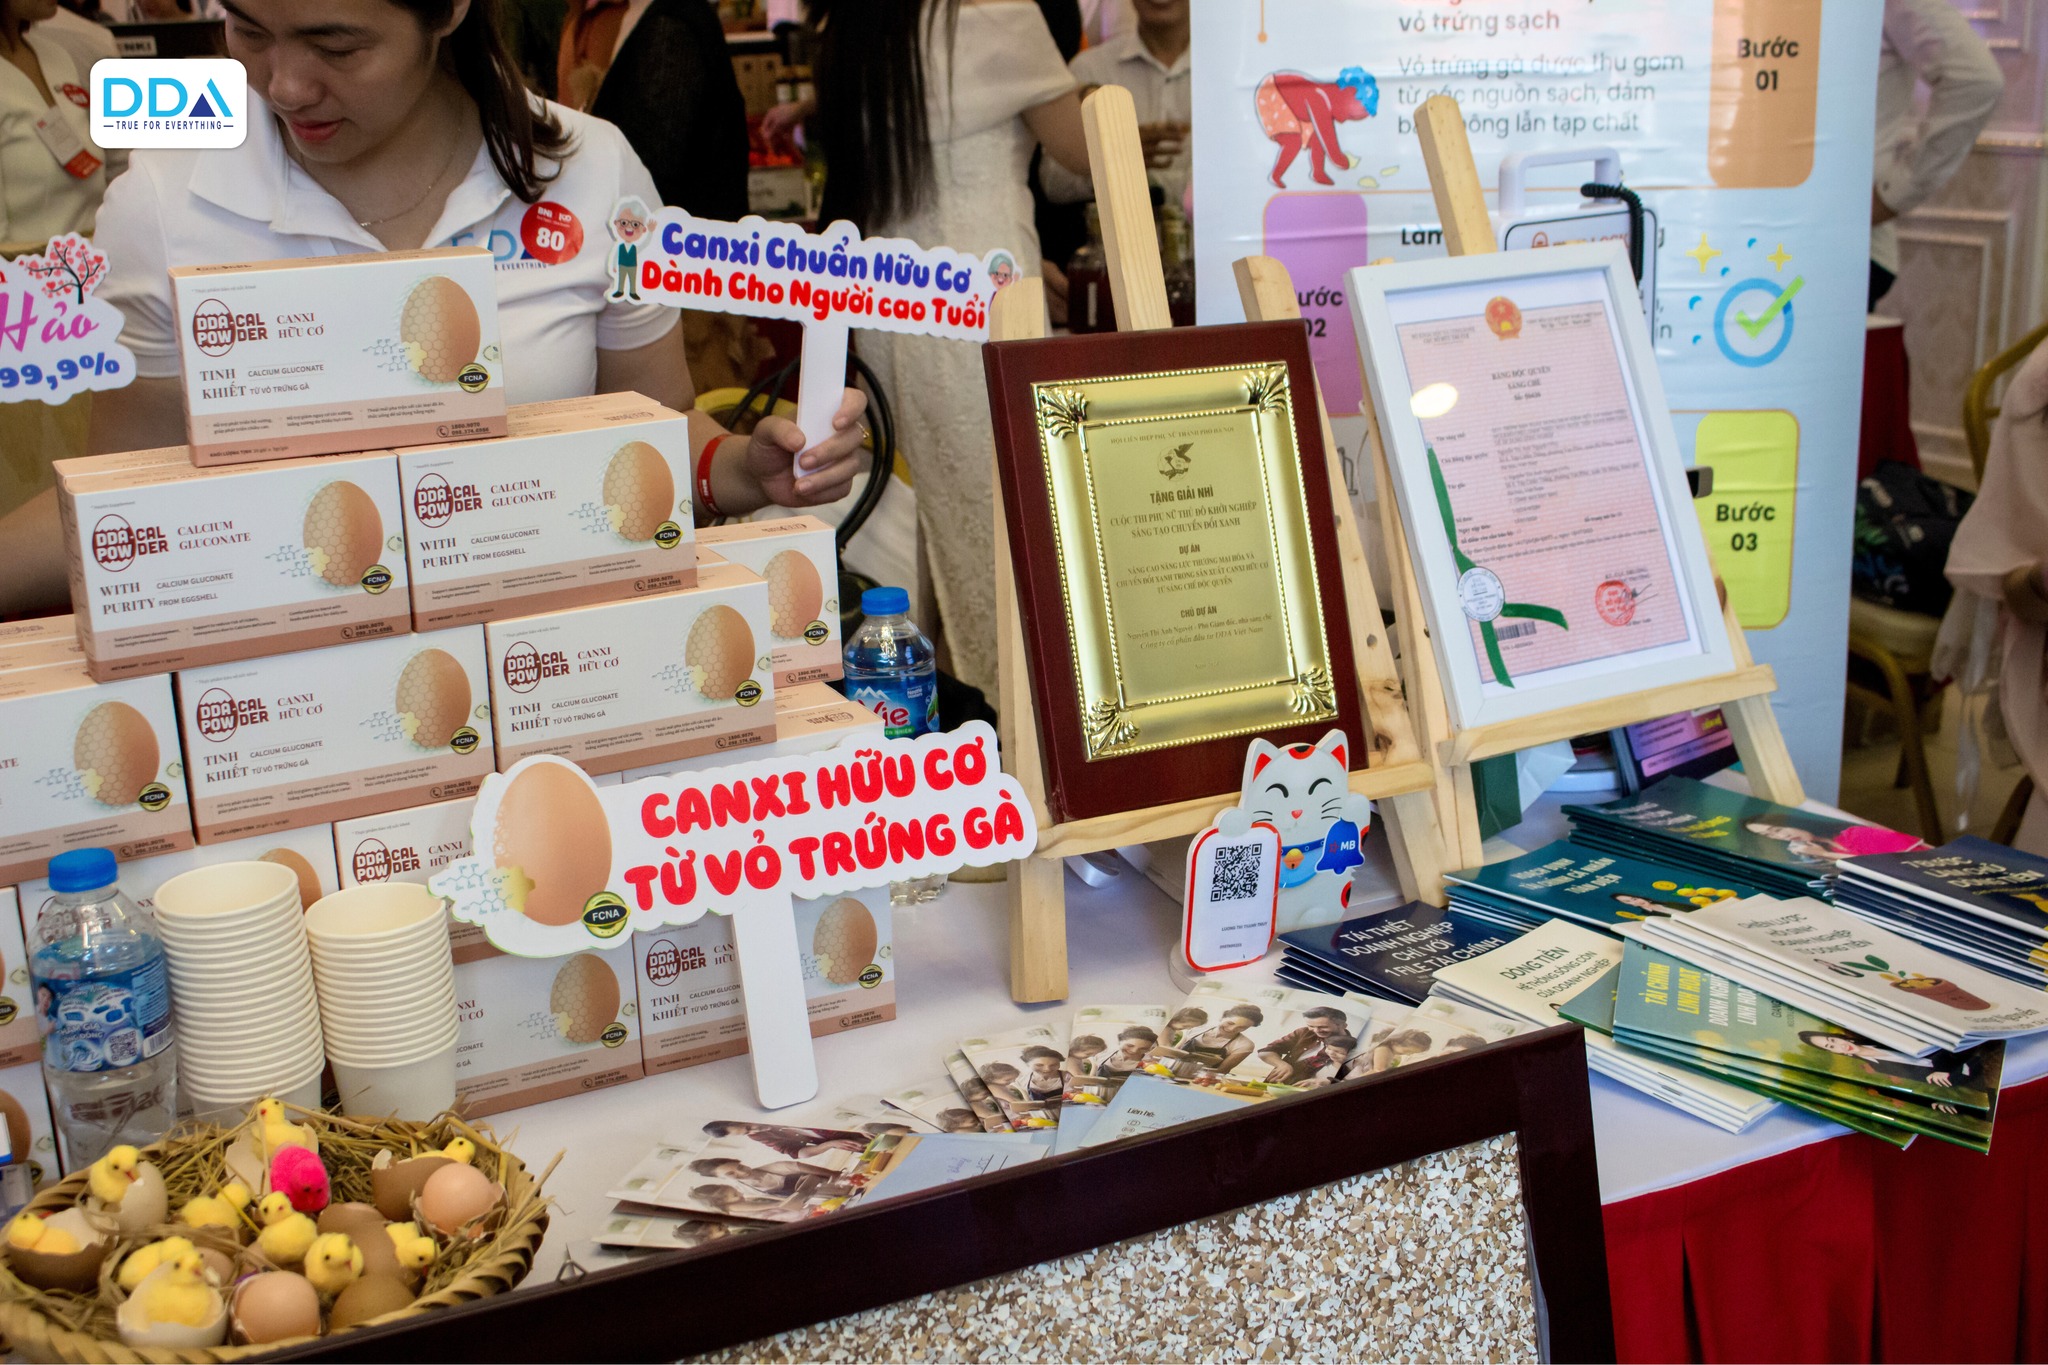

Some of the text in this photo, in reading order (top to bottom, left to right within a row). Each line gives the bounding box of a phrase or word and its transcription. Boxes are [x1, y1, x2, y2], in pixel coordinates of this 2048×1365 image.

[1399, 10, 1560, 36] vỏ trứng sạch
[1737, 35, 1799, 58] Bước
[1593, 54, 1626, 72] thu
[1633, 55, 1684, 75] gom
[1756, 69, 1778, 91] 01
[1399, 84, 1420, 102] từ
[1473, 81, 1539, 107] nguồn
[1553, 114, 1586, 139] tạp
[1592, 111, 1639, 131] chất
[536, 227, 565, 251] 80
[502, 262, 547, 271] EVERYTHING
[661, 223, 971, 293] Canxi Chuẩn Hữu Cơ
[641, 260, 985, 329] Dành Cho Người cao Tuổi
[1298, 286, 1343, 307] ước
[0, 290, 99, 352] Hảo
[196, 313, 315, 330] DDA-CAL CANXI
[278, 327, 303, 338] HỮU
[307, 325, 324, 336] CƠ
[0, 352, 120, 390] 99,9%
[200, 364, 324, 381] TINH CALCIUM GLUCONATE
[463, 374, 483, 382] FCNA
[202, 381, 309, 399] KHIẾT TỪ VỎ TRỨNG GÀ
[418, 479, 541, 503] DDA-CAL CALCIUM
[491, 490, 557, 508] GLUCONATE
[1150, 484, 1214, 505] TẶNG GIẢI NHÌ
[1134, 514, 1147, 523] THI
[1149, 513, 1164, 522] PHỤ
[1229, 500, 1257, 512] NGHIỆP
[1715, 503, 1776, 523] Bước
[95, 520, 233, 547] DDA-CAL CALCIUM
[659, 531, 677, 539] FCNA
[1155, 526, 1170, 536] TẠO
[1220, 517, 1240, 527] XANH
[179, 532, 251, 550] GLUCONATE
[420, 529, 540, 552] WITH CALCIUM GLUCONATE
[1731, 533, 1758, 552] 03
[422, 547, 526, 569] PURITY FROM EGGSHELL
[100, 572, 234, 597] WITH CALCIUM GLUCONATE
[367, 576, 387, 584] FCNA
[103, 592, 218, 615] PURITY FROM EGGSHELL
[1180, 606, 1195, 618] CHỦ
[808, 629, 825, 637] FCNA
[508, 647, 612, 670] DDA-CAL CANXI
[579, 656, 619, 674] HỮU CƠ
[509, 692, 619, 717] TINH CALCIUM GLUCONATE
[740, 689, 757, 698] FCNA
[201, 693, 314, 719] DDA-CAL CANXI
[279, 703, 323, 720] HỮU CƠ
[511, 712, 551, 732] KHIẾT
[553, 717, 564, 726] TỪ
[573, 712, 596, 722] TRỨNG
[596, 709, 606, 718] GÀ
[456, 736, 474, 745] FCNA
[204, 740, 323, 766] TINH CALCIUM GLUCONATE
[206, 764, 249, 783] KHIẾT
[252, 766, 263, 775] TỪ
[274, 761, 298, 771] TRỨNG
[299, 758, 309, 767] GÀ
[640, 734, 989, 839] CANXI HỮU CƠ
[356, 840, 463, 868] DDA-CAL CANXI
[623, 788, 1024, 912] TỪ VỎ TRỨNG GÀ
[1340, 840, 1356, 851] MB
[592, 907, 621, 923] FCNA
[1339, 919, 1415, 943] TÁI THIẾT
[1341, 921, 1454, 957] DOANH NGHIỆP
[649, 946, 705, 966] DDA-CAL
[1391, 939, 1455, 961] CHỈ VỚI
[1393, 962, 1433, 976] FILE
[1428, 955, 1458, 968] TÀI
[1453, 936, 1506, 960] CHÍNH
[1499, 946, 1570, 980] DÒNG TIỀN
[1526, 972, 1558, 987] THỐNG
[1554, 961, 1580, 976] SỐNG
[863, 972, 879, 980] FCNA
[1537, 958, 1611, 998] CỦA DOANH NGHIỆP
[1638, 962, 1670, 1006] TÀI CHÍNH
[651, 989, 715, 1007] TINH CALCIUM
[1677, 967, 1707, 1015] LINH HOẠT
[469, 1009, 484, 1020] CƠ
[652, 1004, 688, 1021] KHIẾT
[1708, 998, 1728, 1027] DOANH
[1737, 1004, 1757, 1026] LINH
[605, 1030, 622, 1039] FCNA
